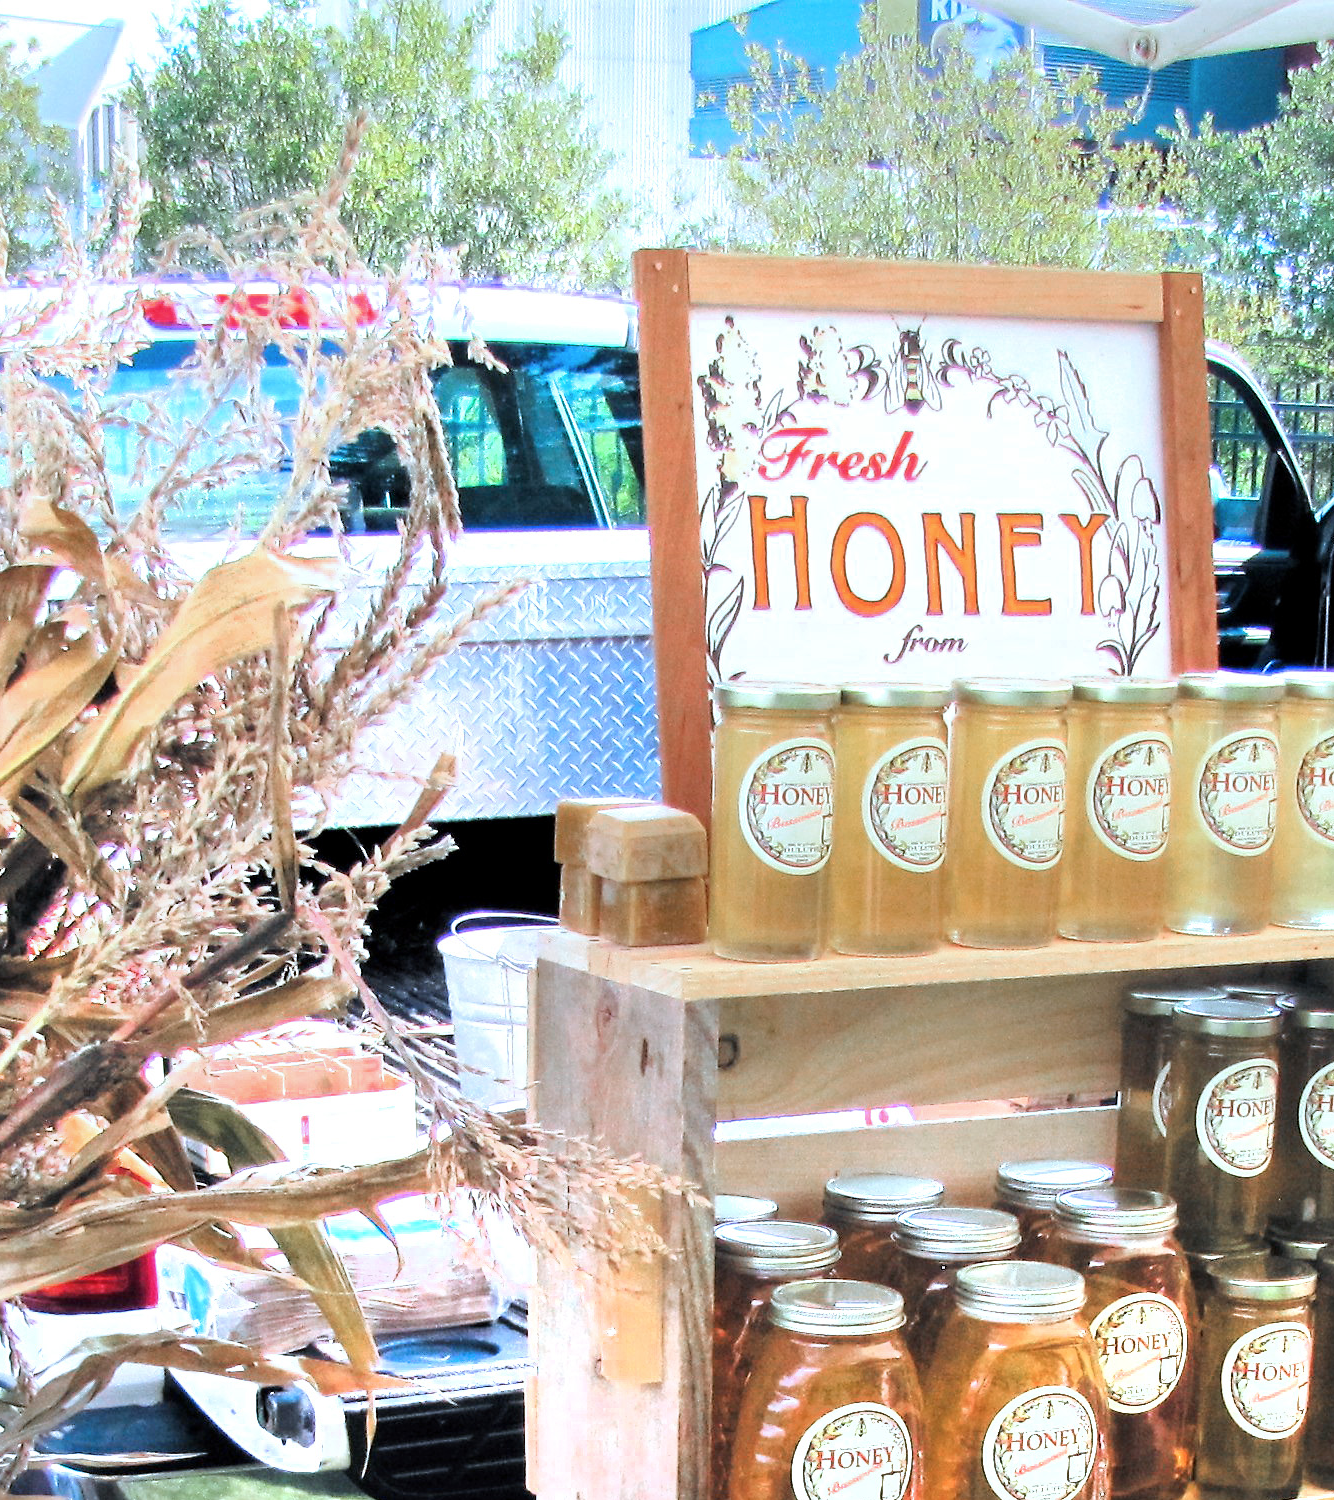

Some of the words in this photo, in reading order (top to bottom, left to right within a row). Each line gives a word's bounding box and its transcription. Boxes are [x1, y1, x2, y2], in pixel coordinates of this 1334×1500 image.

[758, 427, 928, 482] Fresh
[746, 494, 1111, 618] HONEY
[883, 624, 968, 664] from
[1104, 1335, 1172, 1357] HONEY
[1005, 1427, 1081, 1452] HONEY
[816, 1446, 895, 1470] HONEY
